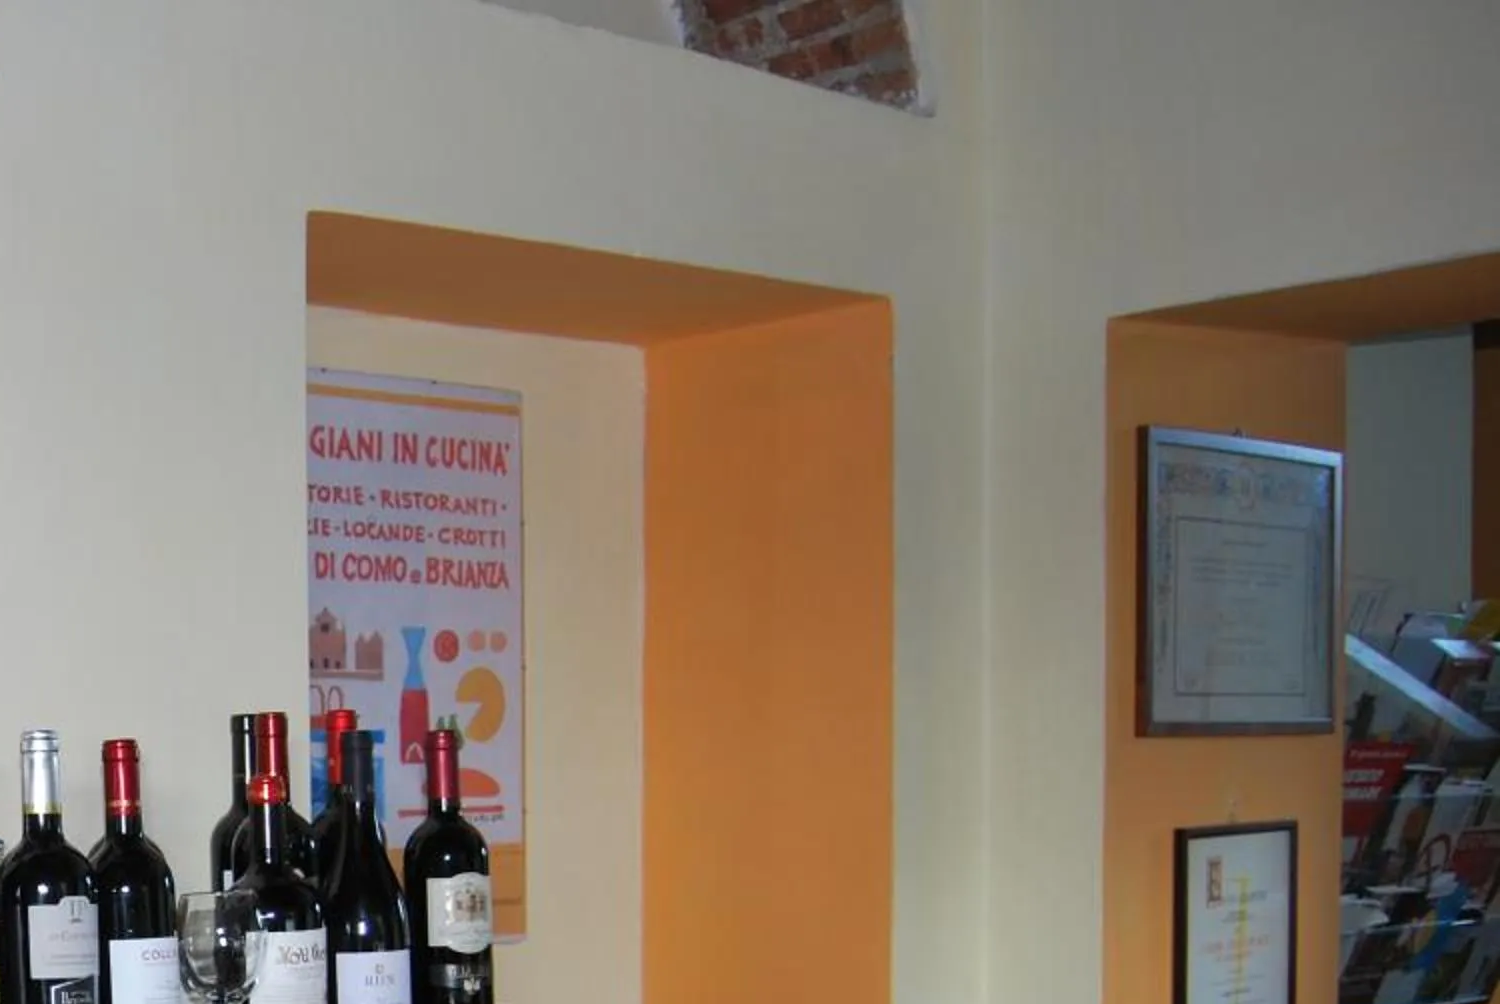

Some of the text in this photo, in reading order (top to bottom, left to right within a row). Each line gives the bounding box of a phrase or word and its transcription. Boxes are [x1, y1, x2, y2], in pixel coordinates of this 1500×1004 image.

[392, 430, 419, 465] IN
[379, 488, 498, 517] RISTORANTI
[343, 519, 426, 544] LOCANDE
[437, 527, 507, 549] CROTTI
[315, 551, 336, 581] DI
[341, 552, 408, 584] COMO
[425, 555, 511, 590] BRIANZA
